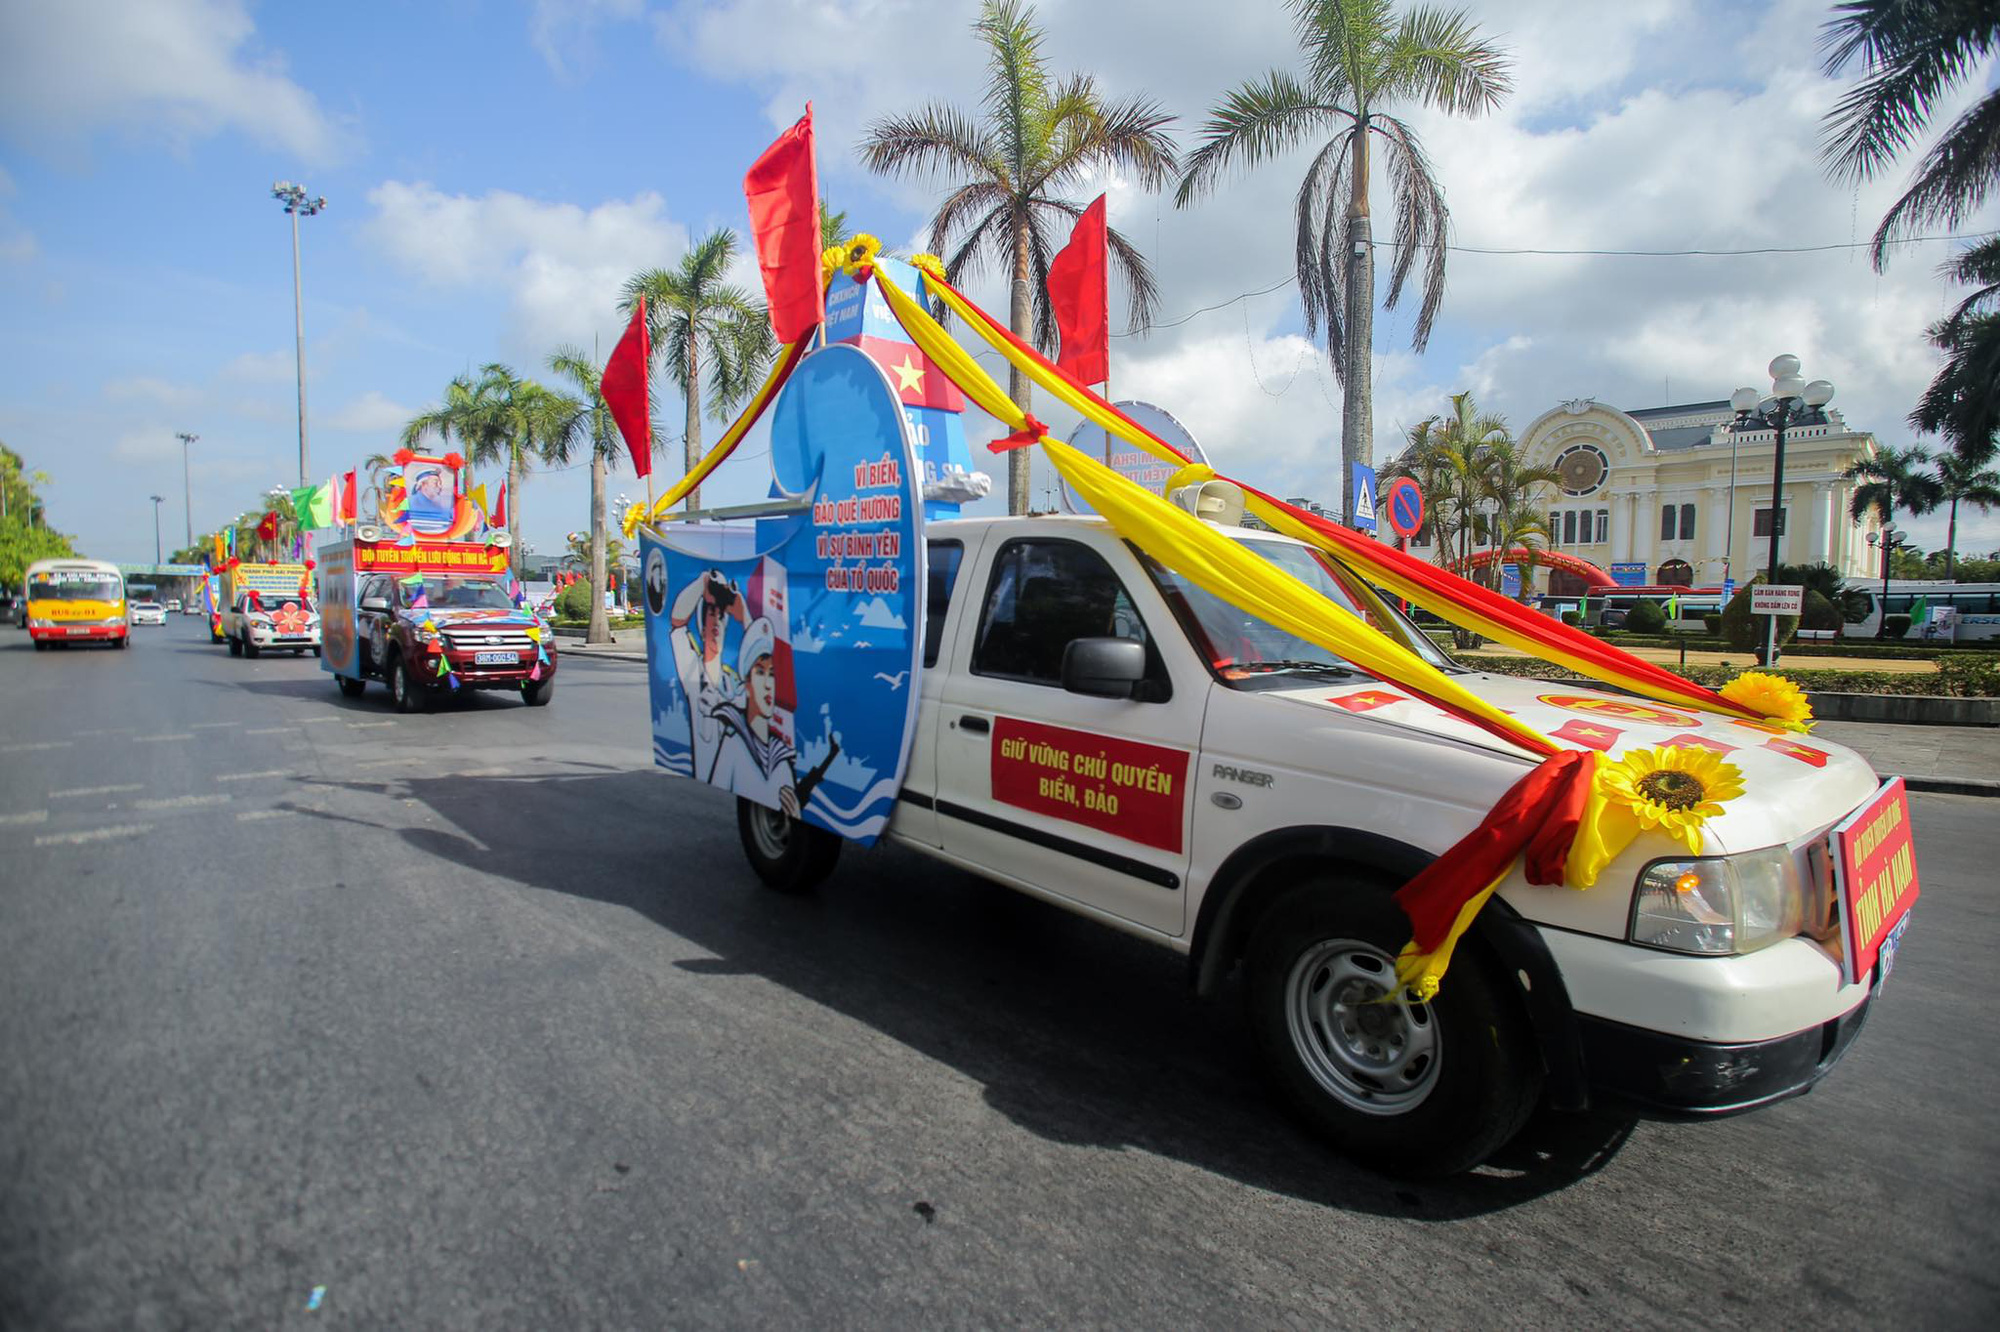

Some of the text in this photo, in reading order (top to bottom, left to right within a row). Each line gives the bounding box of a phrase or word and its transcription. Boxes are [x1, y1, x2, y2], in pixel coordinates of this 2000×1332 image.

[855, 459, 867, 488] VÌ
[837, 496, 858, 526] QUÊ
[860, 496, 901, 522] HƯƠNG
[817, 531, 829, 558] VÌ
[846, 530, 873, 558] BÌNH
[876, 529, 900, 557] YÊN
[826, 561, 849, 591] CỦA
[1001, 737, 1173, 796] GIỮ VỮNG CHỦ QUYỀN
[1212, 763, 1274, 790] RANGER
[1039, 775, 1119, 816] BIỂN, ĐẢO
